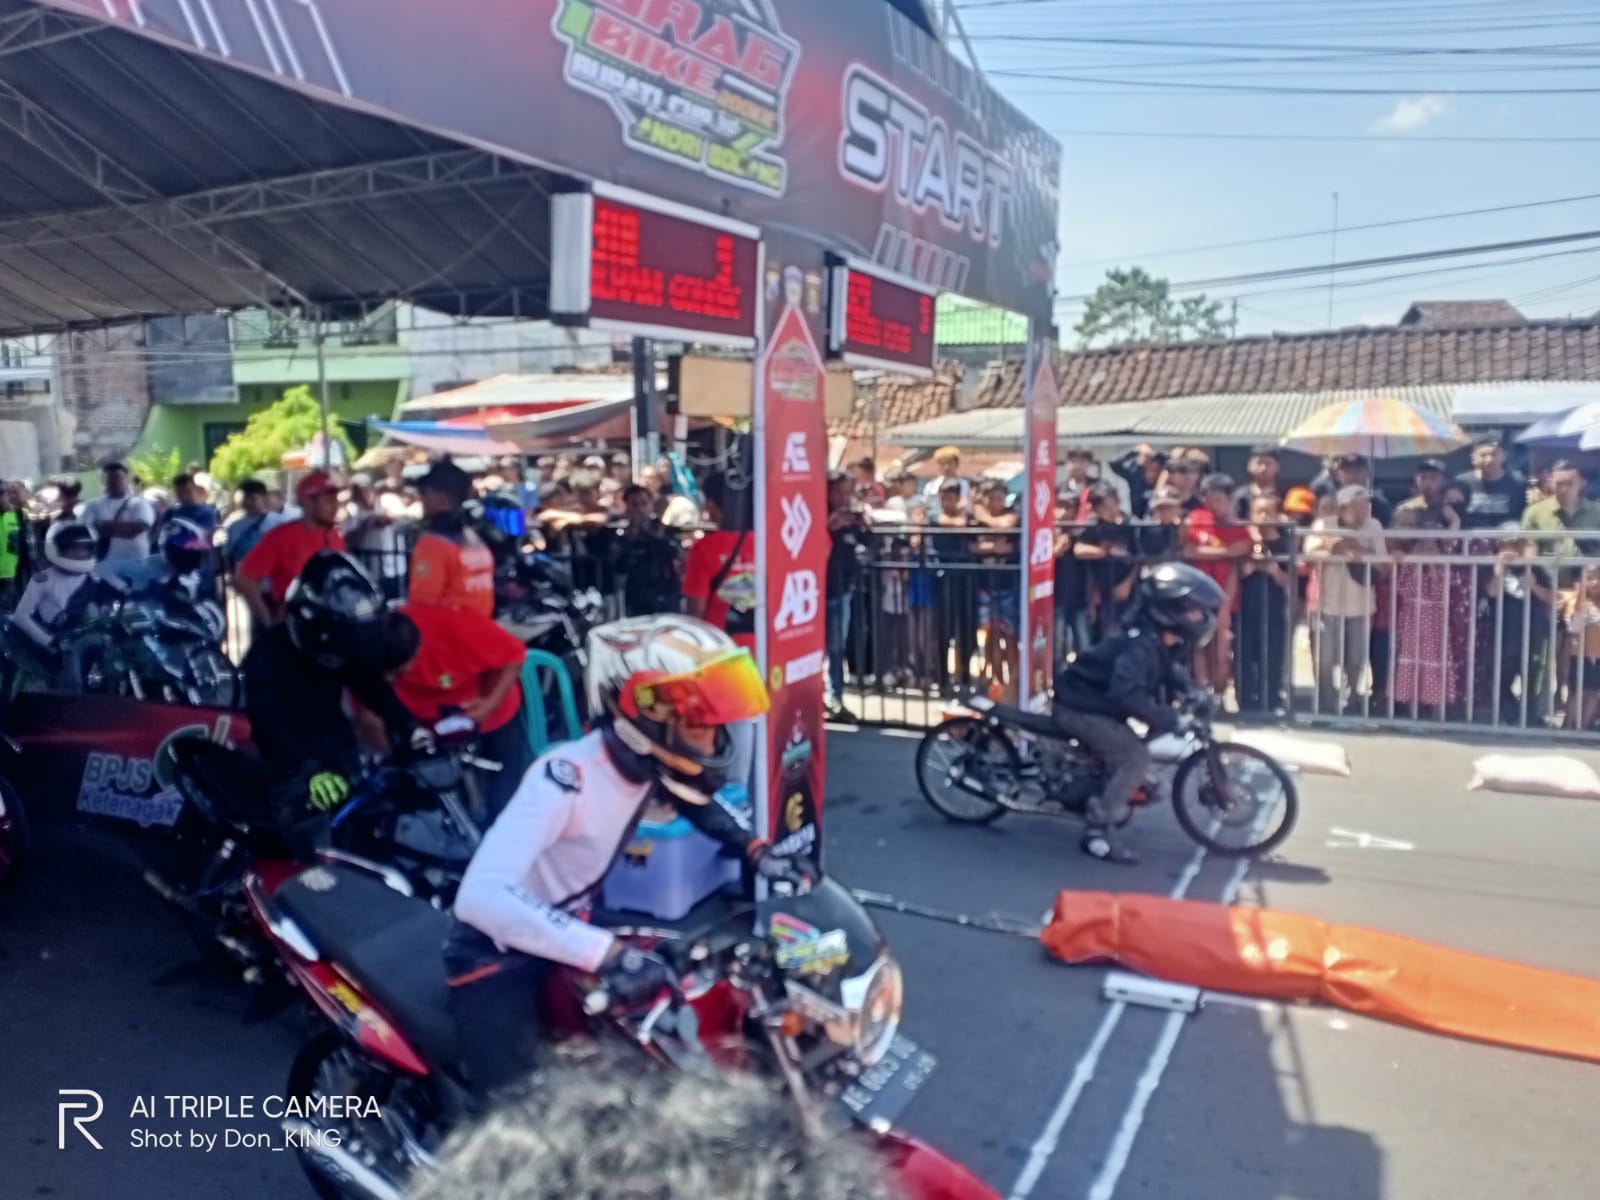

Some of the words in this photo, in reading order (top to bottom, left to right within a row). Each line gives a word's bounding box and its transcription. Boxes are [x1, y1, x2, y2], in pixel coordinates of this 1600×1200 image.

[569, 52, 664, 112] BUPATI
[587, 8, 723, 98] BIKE
[840, 64, 1014, 247] START
[774, 569, 819, 632] AB
[83, 750, 154, 794] BPJS
